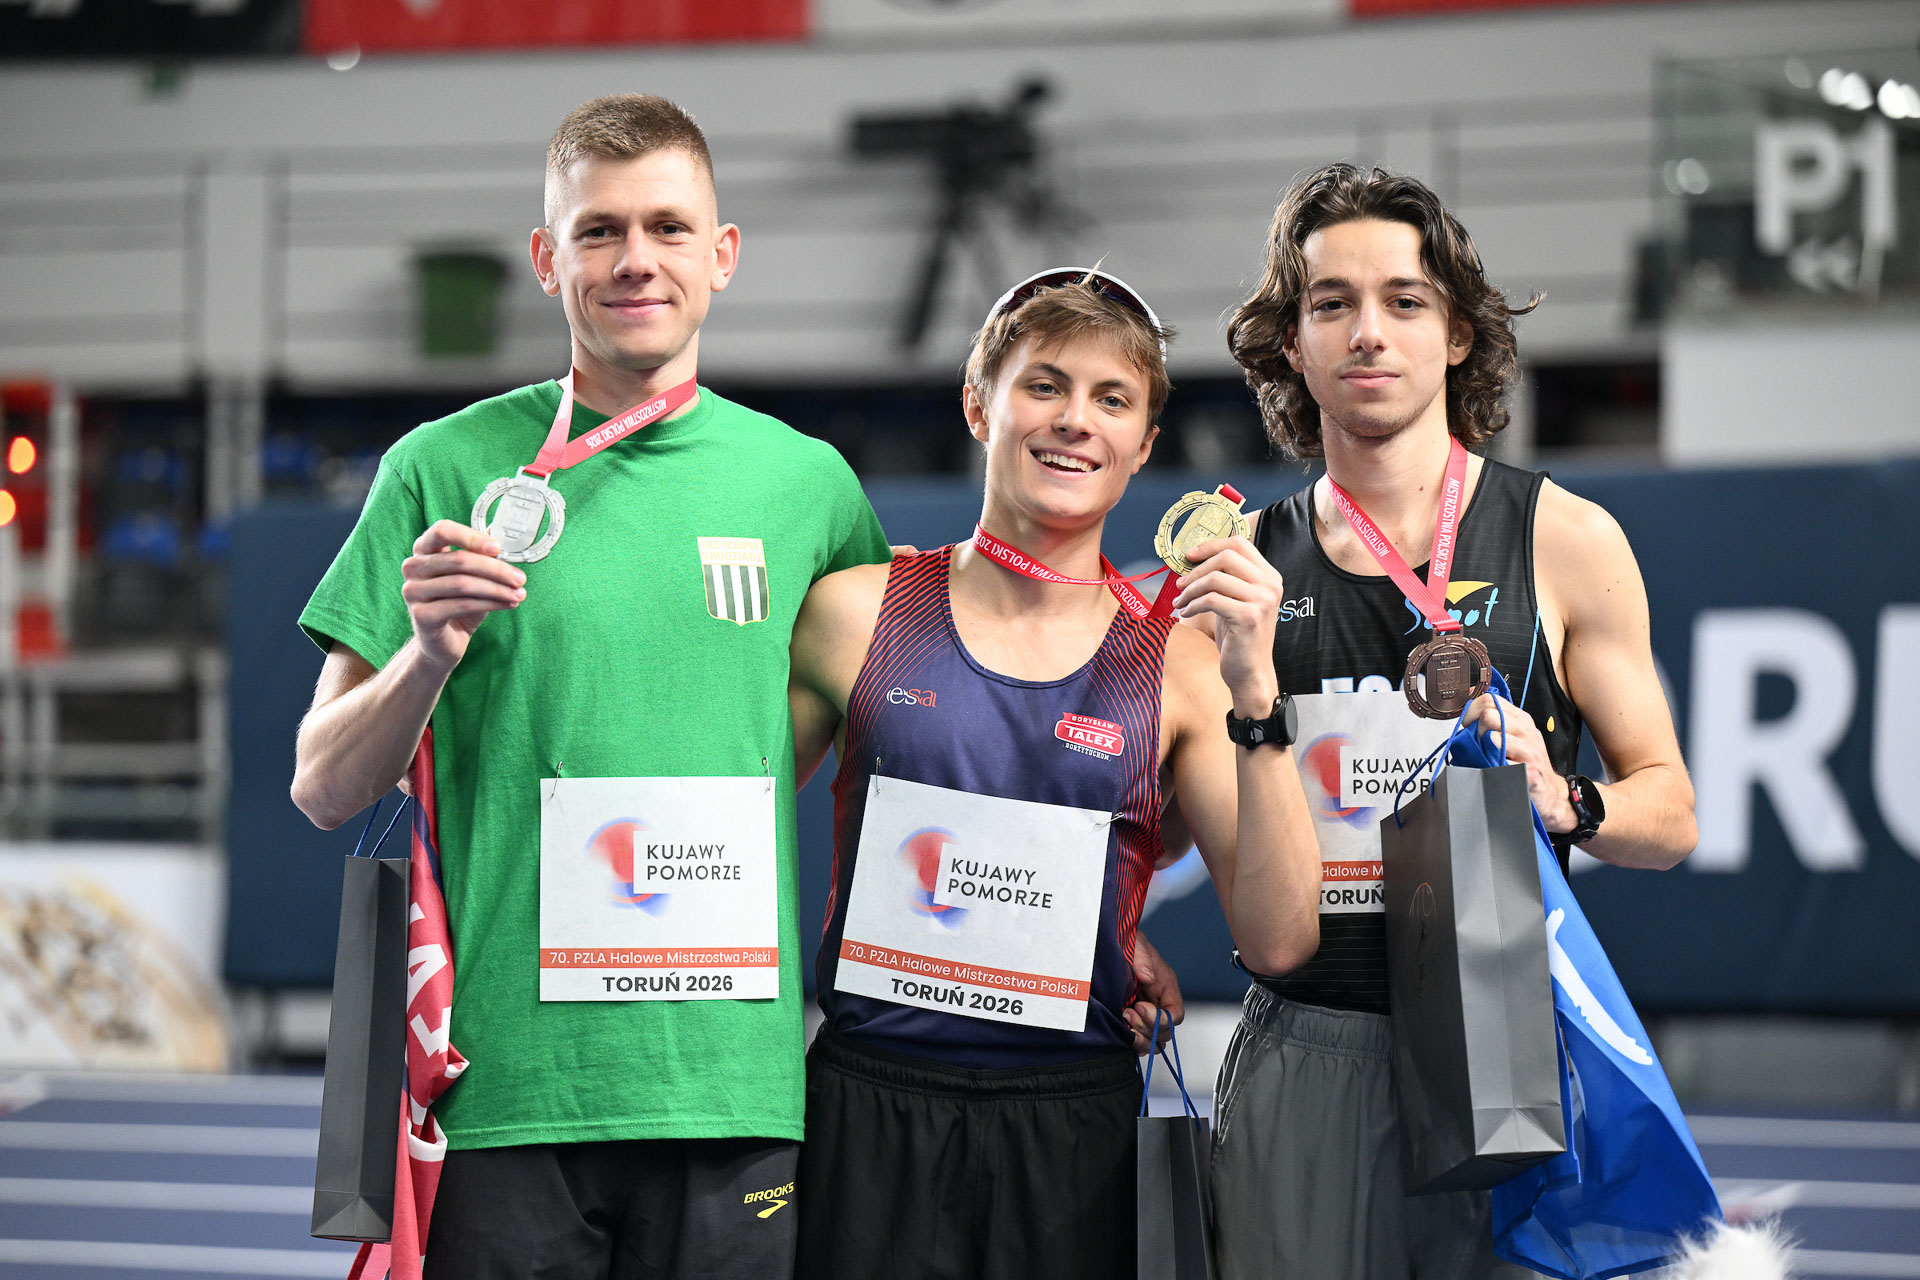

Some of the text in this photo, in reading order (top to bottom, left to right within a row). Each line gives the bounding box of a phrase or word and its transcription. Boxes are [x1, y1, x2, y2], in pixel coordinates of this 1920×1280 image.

[1755, 120, 1897, 252] P1
[585, 397, 667, 450] MISTRZOSTWA POLSKI 2026
[1351, 510, 1391, 558] MISTRZOSTWA
[1433, 477, 1460, 579] MISTRZOSTWA POLSKI 2026
[975, 533, 992, 551] 202
[990, 542, 1031, 571] POLSKI
[1276, 596, 1317, 622] sa
[1071, 715, 1115, 730] BORYSŁAW
[1064, 724, 1118, 750] TALEX
[1352, 758, 1437, 774] KUJAWY
[1352, 778, 1432, 795] POMOR
[647, 844, 725, 860] KUJAWY
[647, 865, 741, 881] POMORZE
[950, 857, 1037, 886] KUJAWY
[1321, 864, 1369, 877] Halowe
[947, 878, 1054, 909] POMORZE
[549, 950, 771, 964] 70. PZLA Halowe Mistrzostwa Polski
[848, 944, 1080, 996] 70. PZLA Halowe Mistrzostwa Polski
[602, 971, 733, 993] TORUŃ 2026
[891, 978, 1024, 1016] TORUŃ 2026
[743, 1181, 795, 1204] BROOKS
